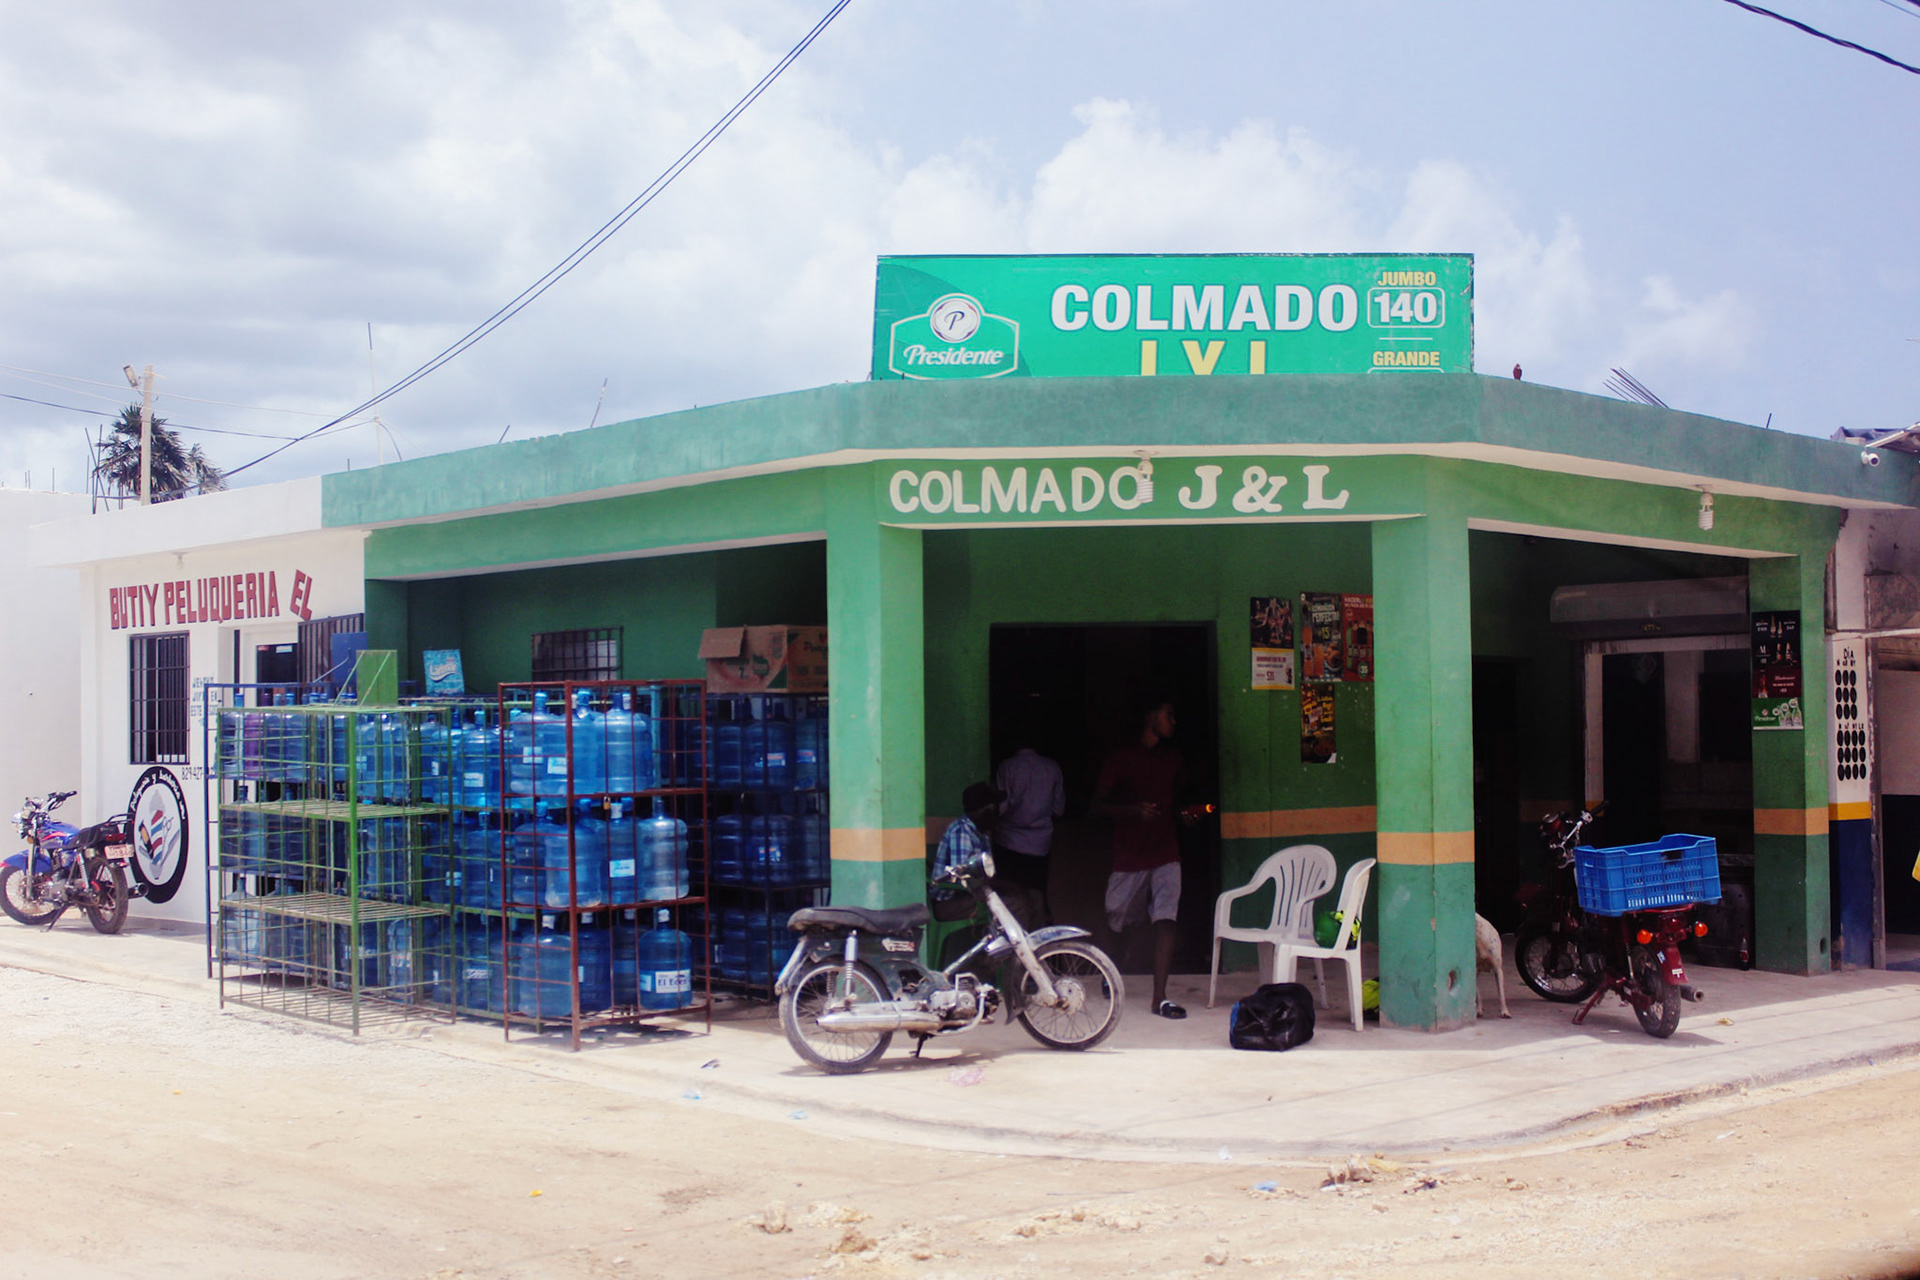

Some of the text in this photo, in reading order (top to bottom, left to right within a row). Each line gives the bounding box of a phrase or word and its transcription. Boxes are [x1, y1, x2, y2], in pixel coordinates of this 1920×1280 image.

[1377, 271, 1437, 286] JUMBO
[1051, 284, 1358, 332] COLMADO
[1373, 291, 1437, 323] 140
[902, 344, 1004, 365] Presidente
[1372, 350, 1441, 366] GRANDE
[889, 467, 1143, 513] COLMADO
[163, 571, 280, 624] PELUQUERIA
[290, 569, 313, 621] EL
